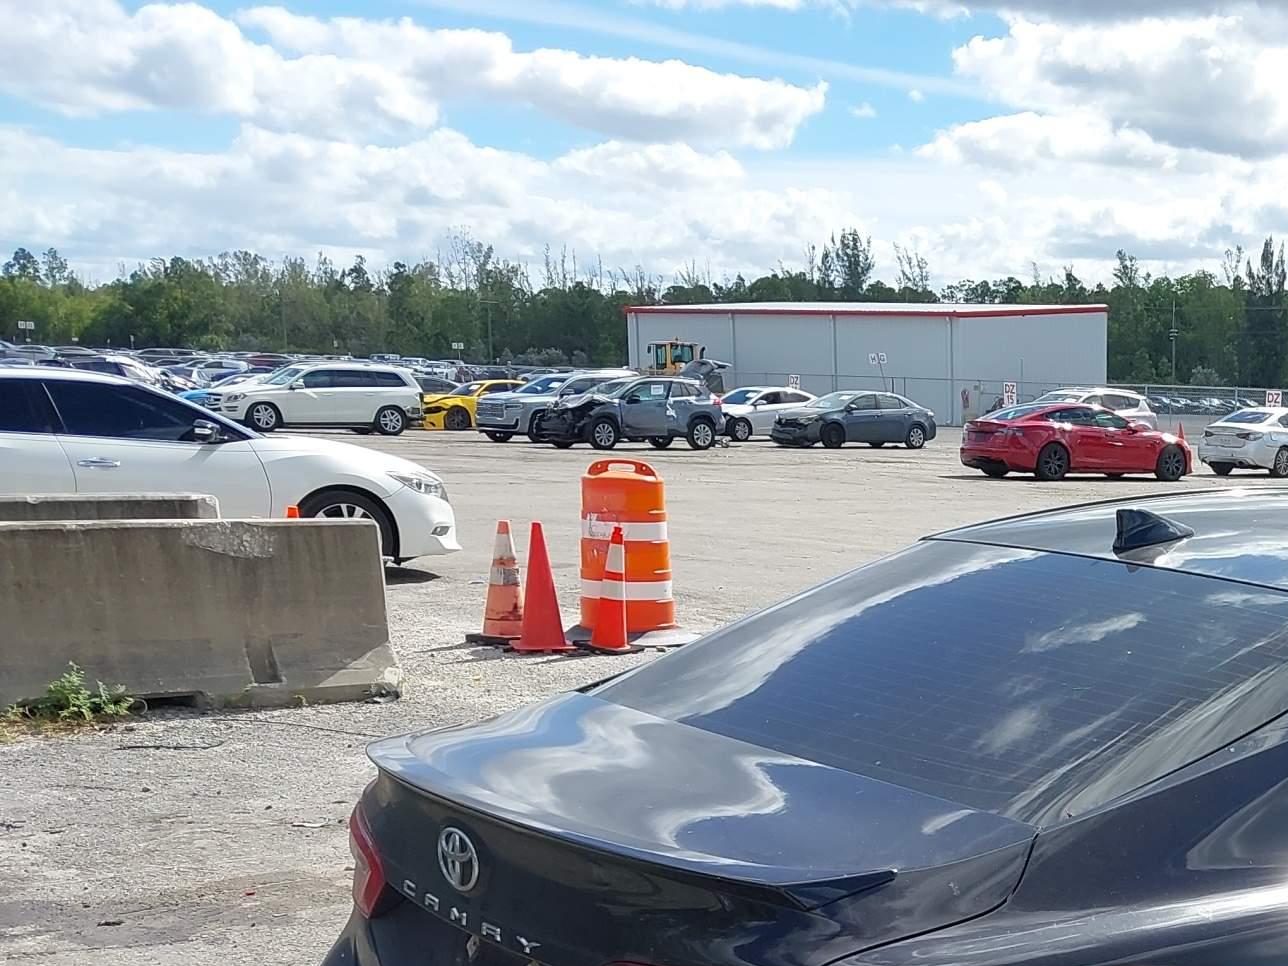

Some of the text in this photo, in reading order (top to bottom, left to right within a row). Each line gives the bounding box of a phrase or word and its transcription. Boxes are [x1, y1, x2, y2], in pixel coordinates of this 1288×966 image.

[790, 375, 799, 385] DZ
[1004, 383, 1016, 394] DZ
[1006, 394, 1015, 405] 15
[1267, 392, 1281, 404] DZ
[402, 879, 541, 954] CAMRY
